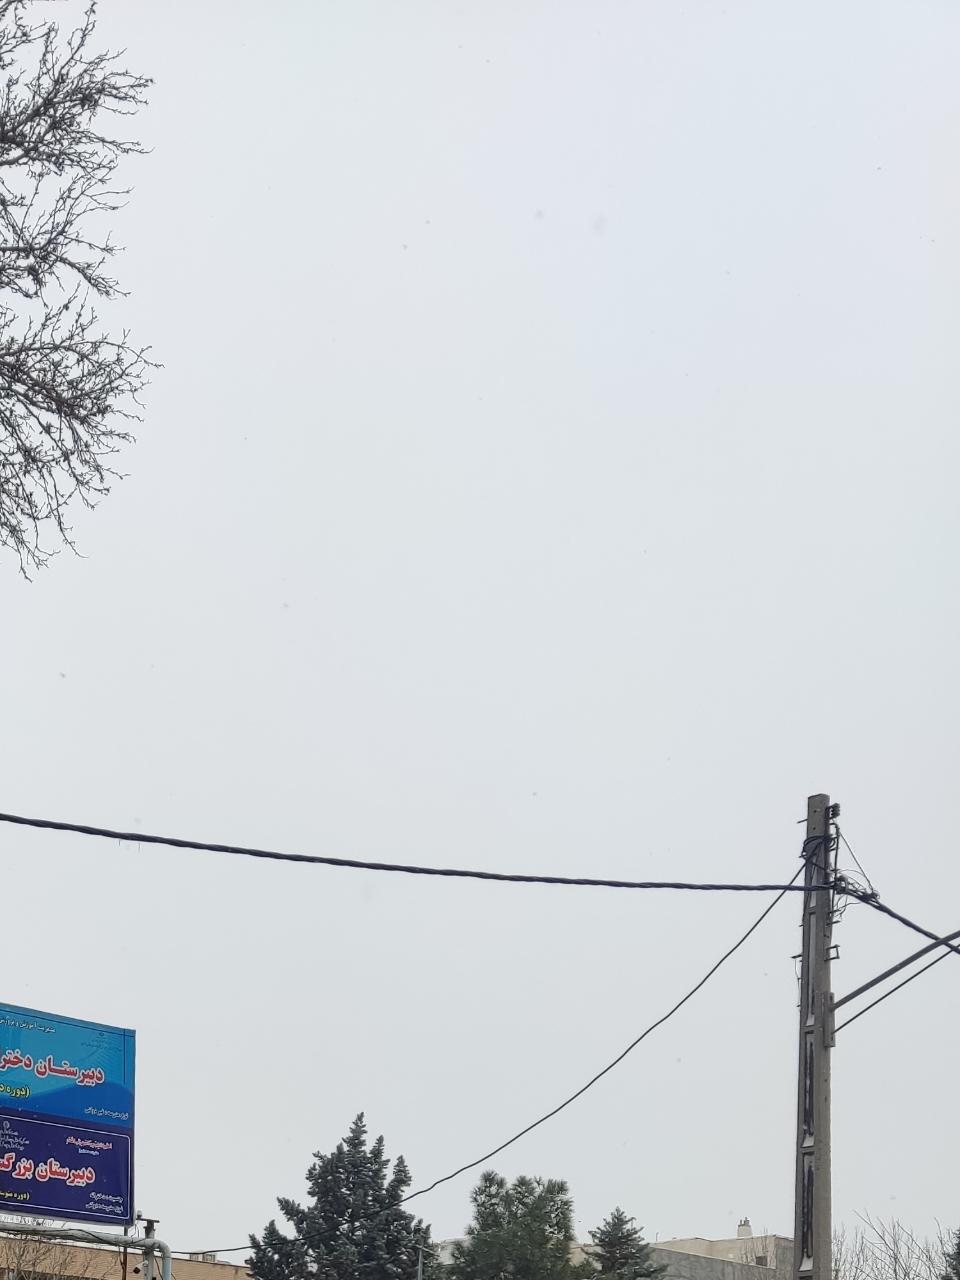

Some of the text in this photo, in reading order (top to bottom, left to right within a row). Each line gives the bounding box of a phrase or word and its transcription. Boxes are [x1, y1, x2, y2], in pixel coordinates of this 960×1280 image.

[36, 1055, 104, 1086] دبیرستان
[6, 1085, 31, 1098] (دوره
[35, 1158, 96, 1187] دبیرستان
